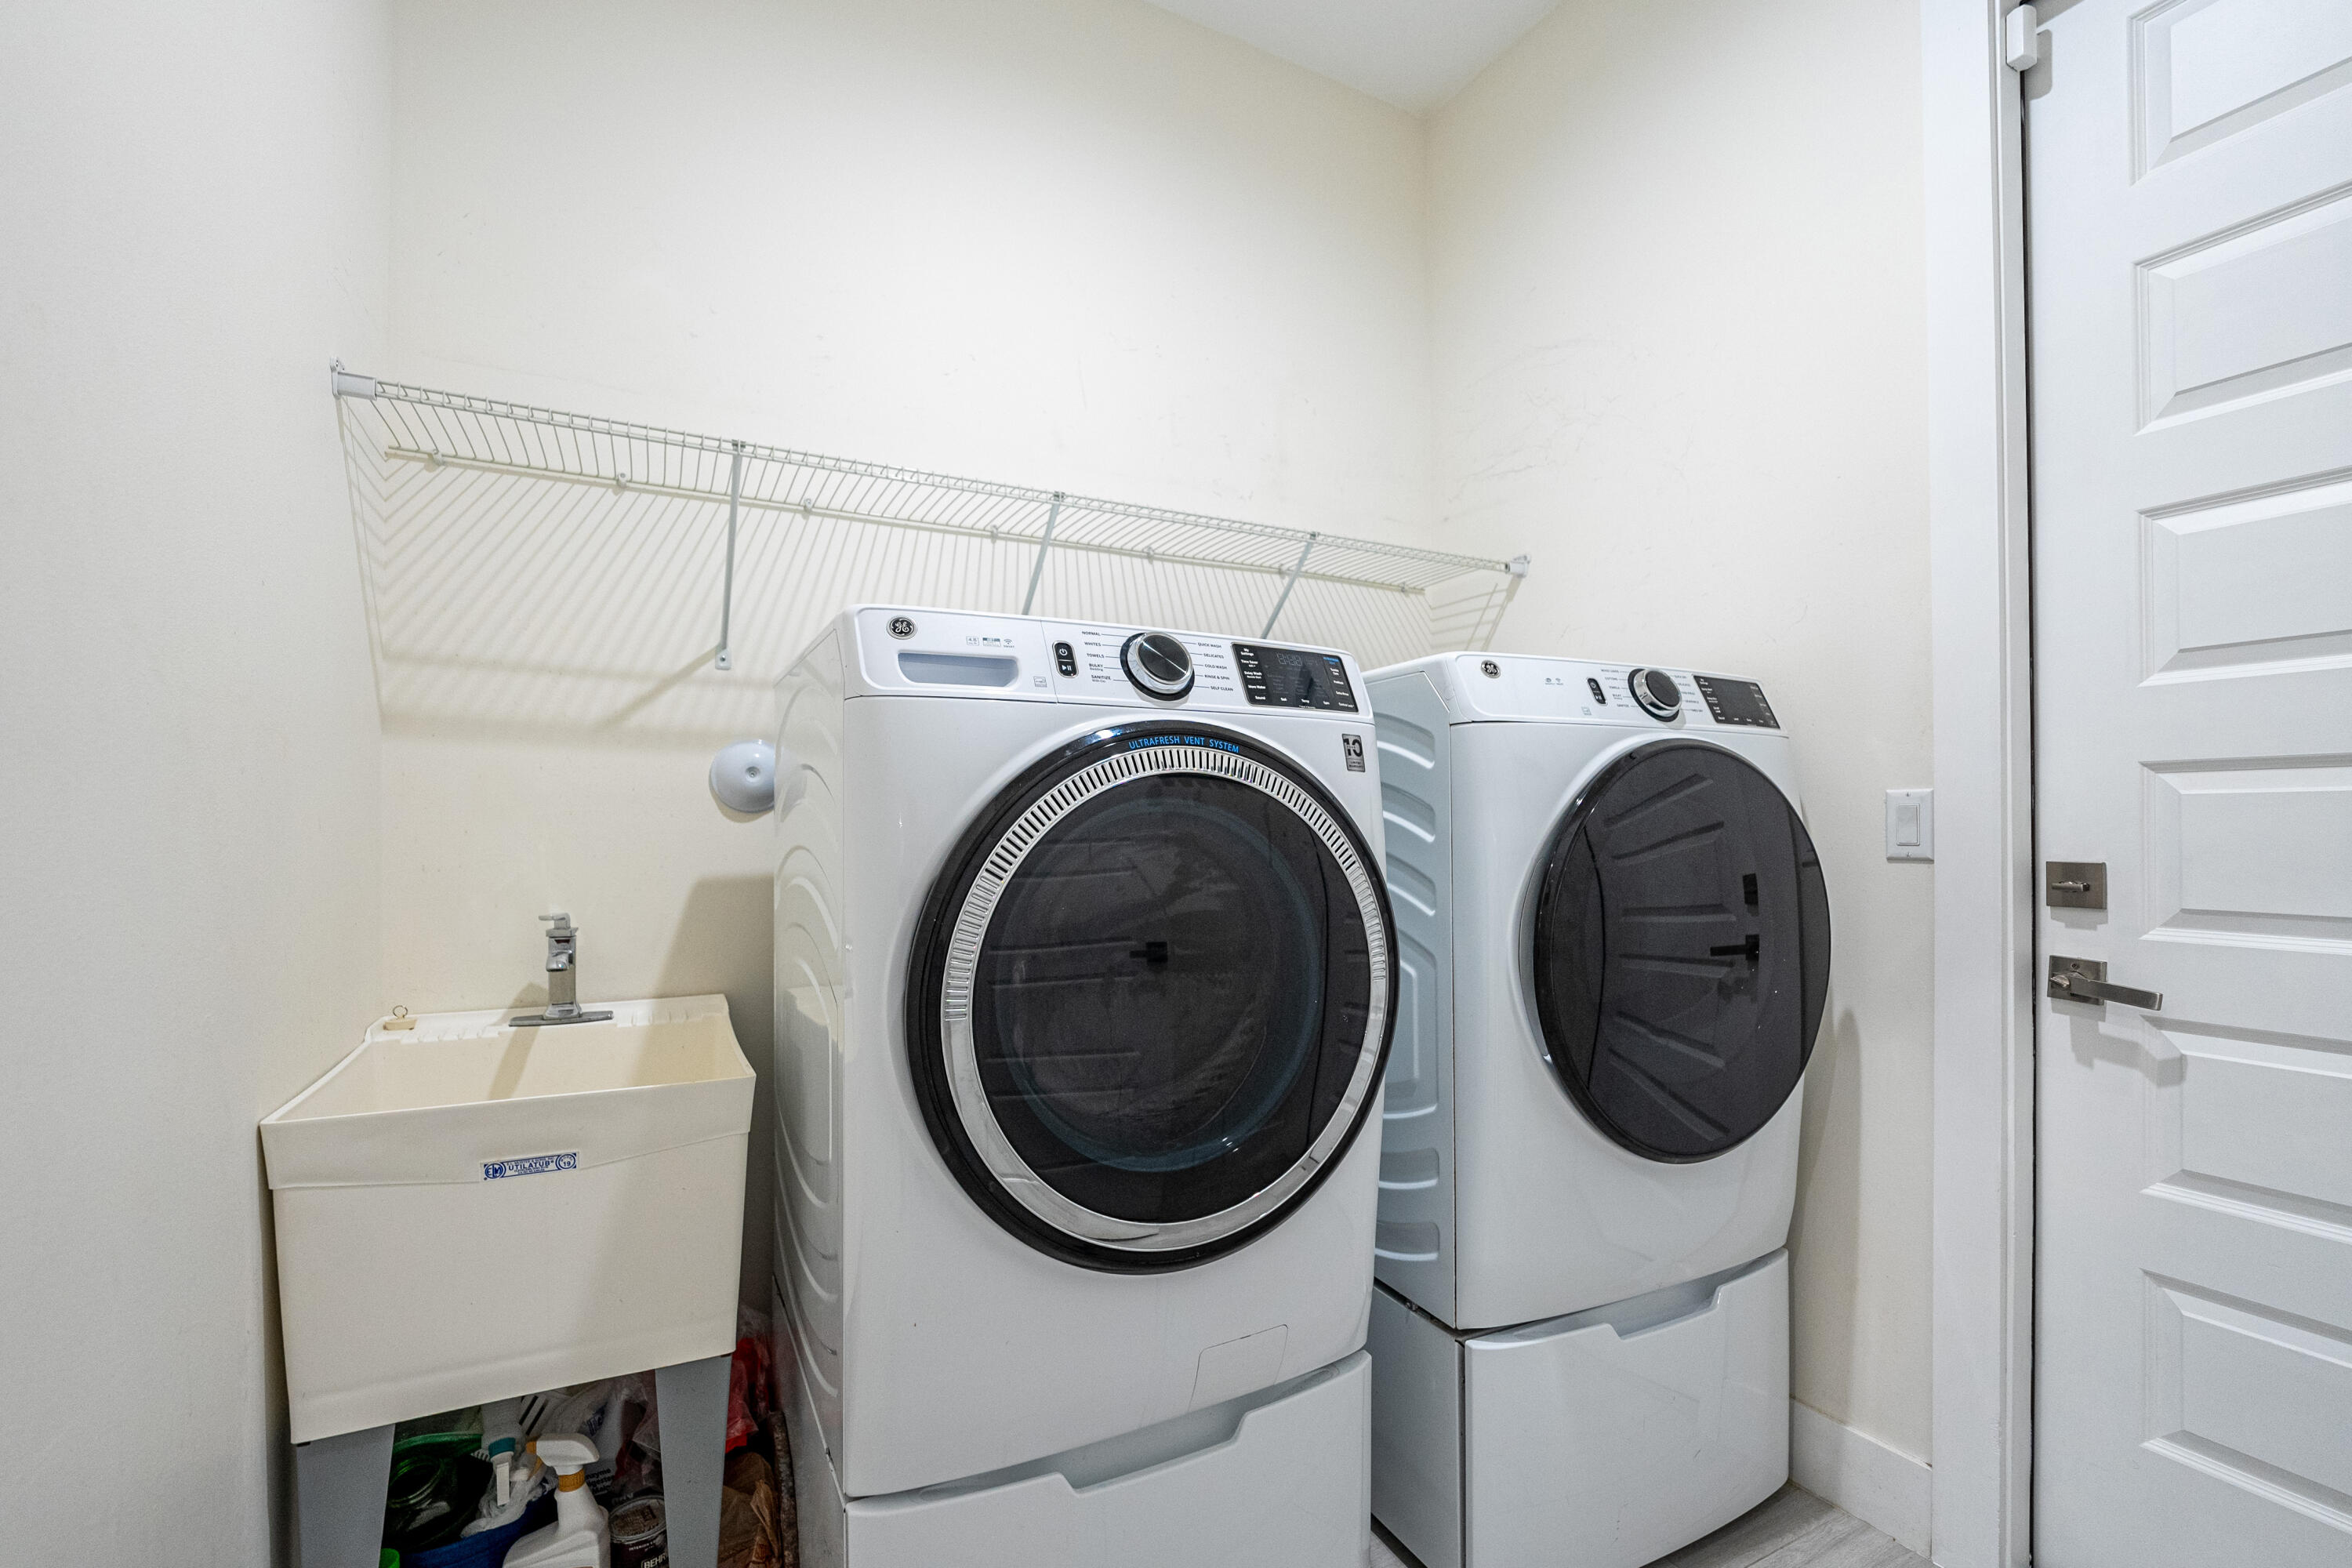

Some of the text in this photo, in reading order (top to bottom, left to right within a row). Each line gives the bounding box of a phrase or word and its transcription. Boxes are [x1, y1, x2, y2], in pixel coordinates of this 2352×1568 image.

[1129, 736, 1239, 753] ULTRAFRESH VENT SYSTEM
[1343, 738, 1363, 757] 10
[509, 1160, 550, 1171] UTILATUB
